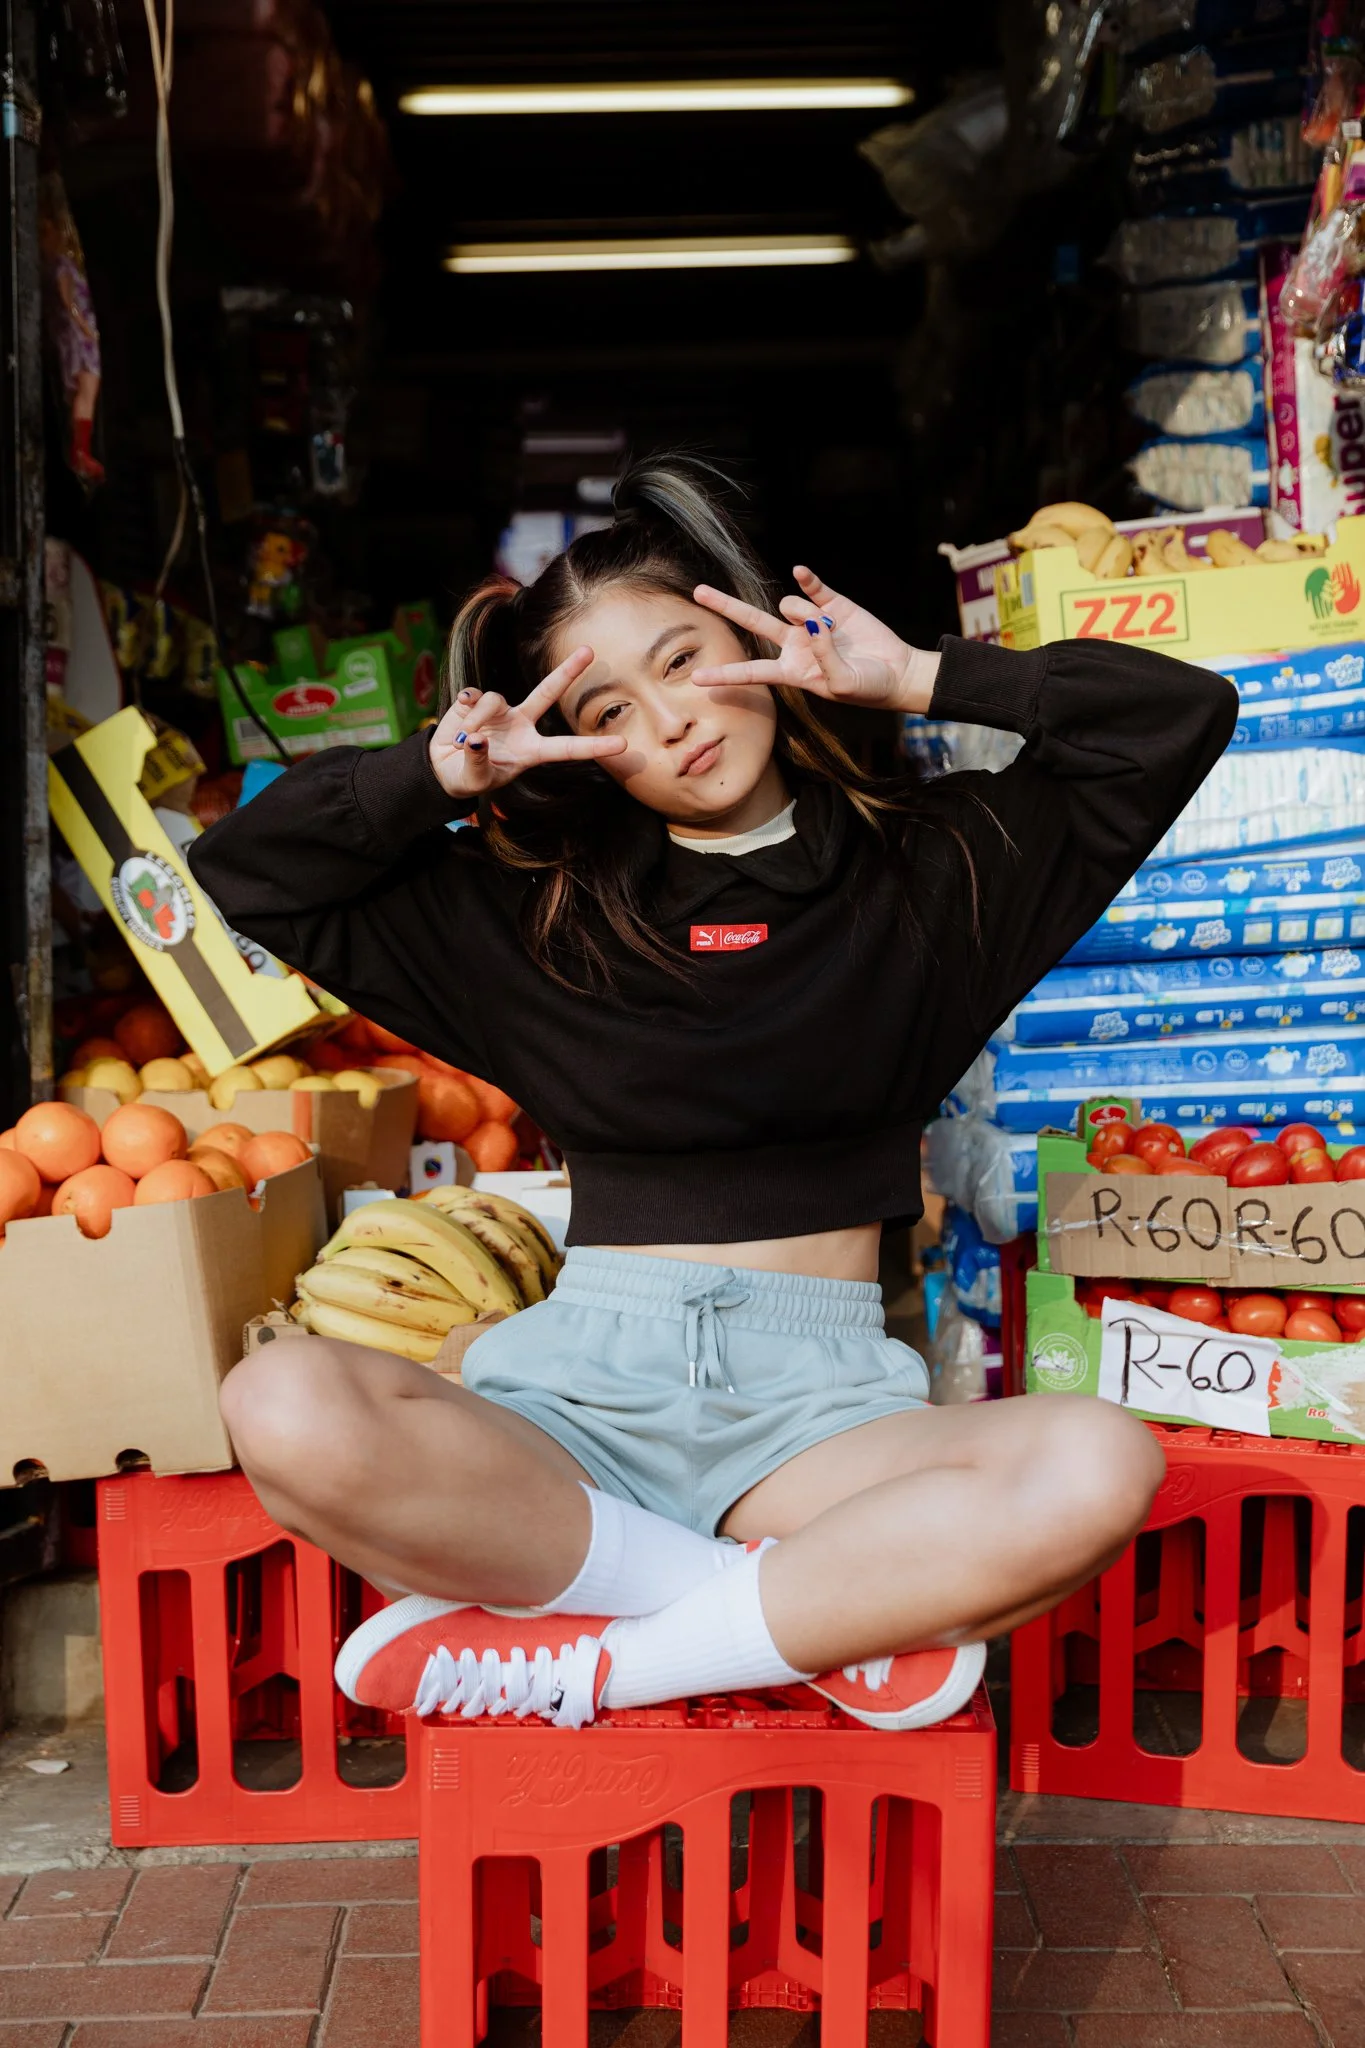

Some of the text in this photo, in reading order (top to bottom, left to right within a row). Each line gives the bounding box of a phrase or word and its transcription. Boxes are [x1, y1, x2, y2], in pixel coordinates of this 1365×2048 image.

[1333, 395, 1365, 516] uper
[1073, 592, 1177, 640] ZZ2
[1190, 929, 1232, 947] Super
[1195, 920, 1226, 936] Soft
[1091, 1187, 1222, 1253] R-60
[1234, 1198, 1365, 1264] R-60
[1108, 1317, 1256, 1406] R-60
